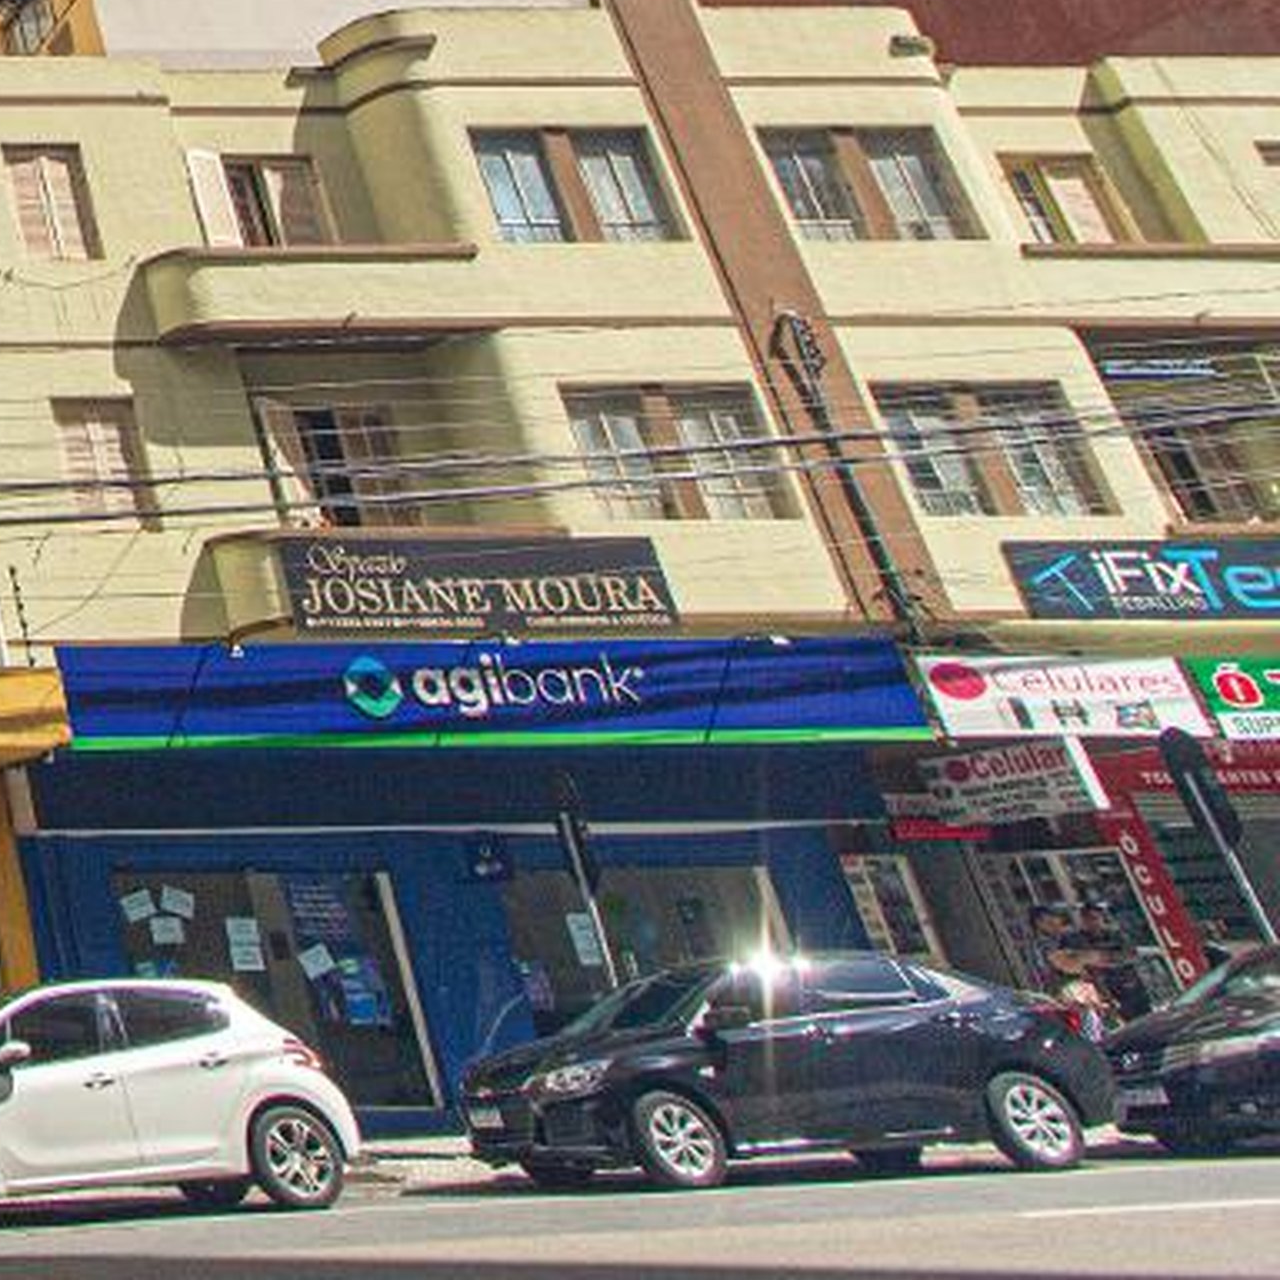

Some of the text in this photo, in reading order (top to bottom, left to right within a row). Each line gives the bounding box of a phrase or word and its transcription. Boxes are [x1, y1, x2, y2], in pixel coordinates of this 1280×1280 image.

[303, 576, 667, 615] JOSIANE MOURA
[412, 653, 641, 718] agibank
